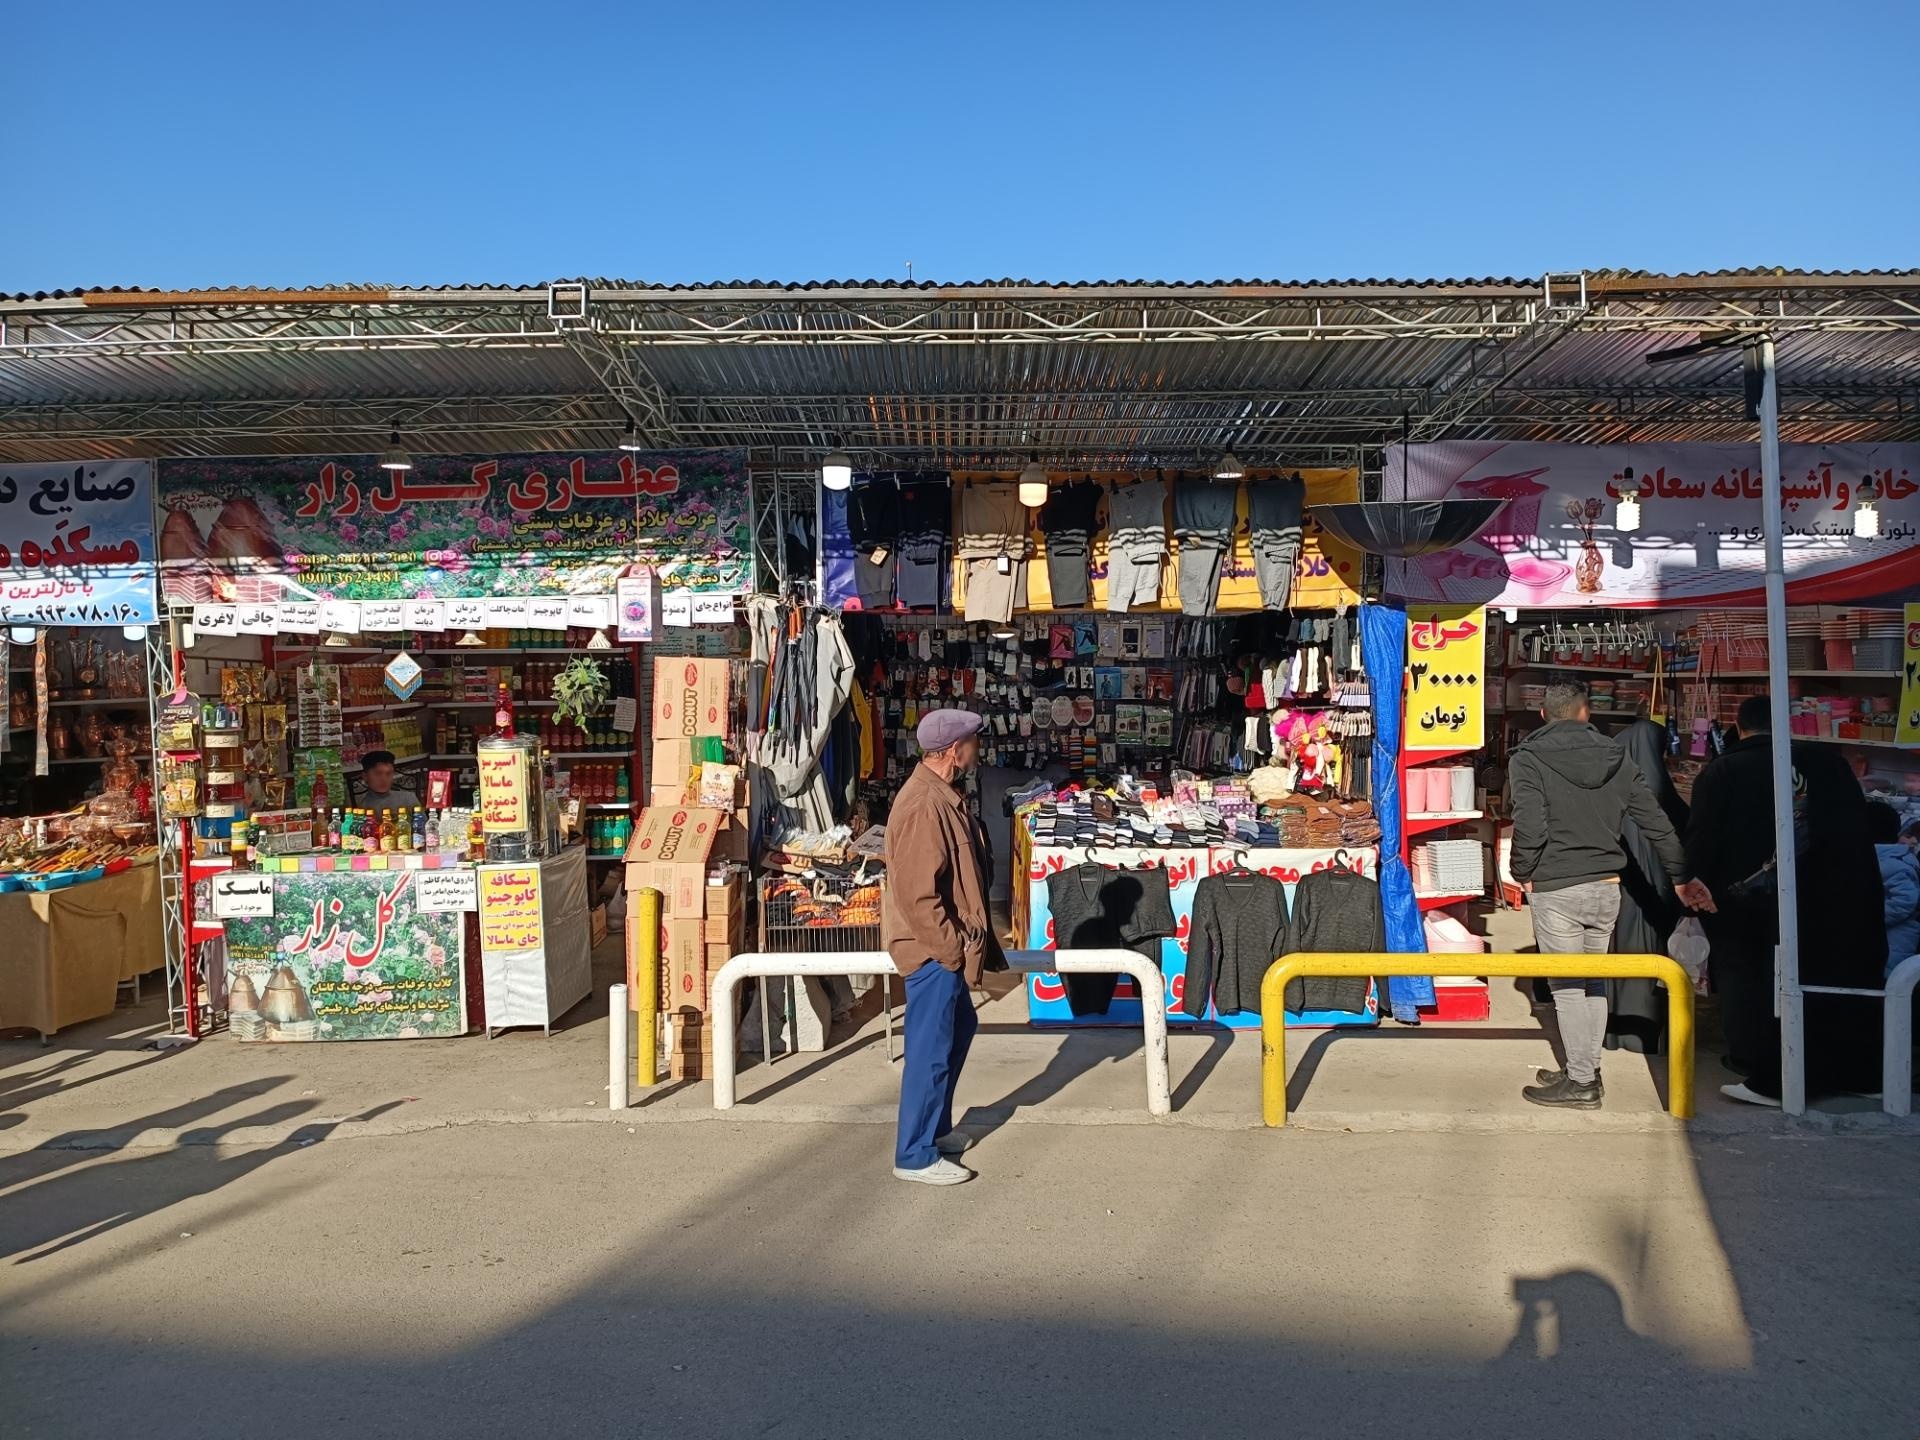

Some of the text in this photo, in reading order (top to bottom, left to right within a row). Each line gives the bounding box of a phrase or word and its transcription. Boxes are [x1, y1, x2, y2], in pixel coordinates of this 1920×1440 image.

[29, 465, 135, 515] صنایع
[296, 456, 680, 517] عطاری گل زار
[1832, 482, 1850, 511] و
[513, 511, 718, 535] عرضه گلاب و عرقیات سنتی
[1730, 527, 1739, 540] و
[298, 571, 400, 584] 09013624481
[455, 604, 477, 613] درمان
[712, 601, 731, 612] انواع
[198, 613, 234, 627] لاغری
[242, 610, 274, 627] چاقی
[1411, 613, 1479, 649] حراج
[1410, 662, 1478, 692] ۳۰۰۰۰
[683, 688, 698, 737] DONUT
[1420, 706, 1466, 730] تومان
[483, 775, 513, 788] ماسالا
[485, 809, 517, 823] نسکافه
[658, 826, 684, 860] DONUT
[490, 872, 531, 886] نسکافه
[218, 880, 271, 896] ماسک
[486, 888, 537, 907] کاپوچینو
[291, 871, 415, 968] گل زار
[486, 933, 539, 946] چای ماسالا
[311, 982, 336, 994] کاشان
[351, 982, 374, 993] درجه
[397, 979, 426, 990] عرقیات
[426, 981, 433, 989] و
[433, 978, 453, 989] گلاب
[427, 1000, 450, 1010] شربت
